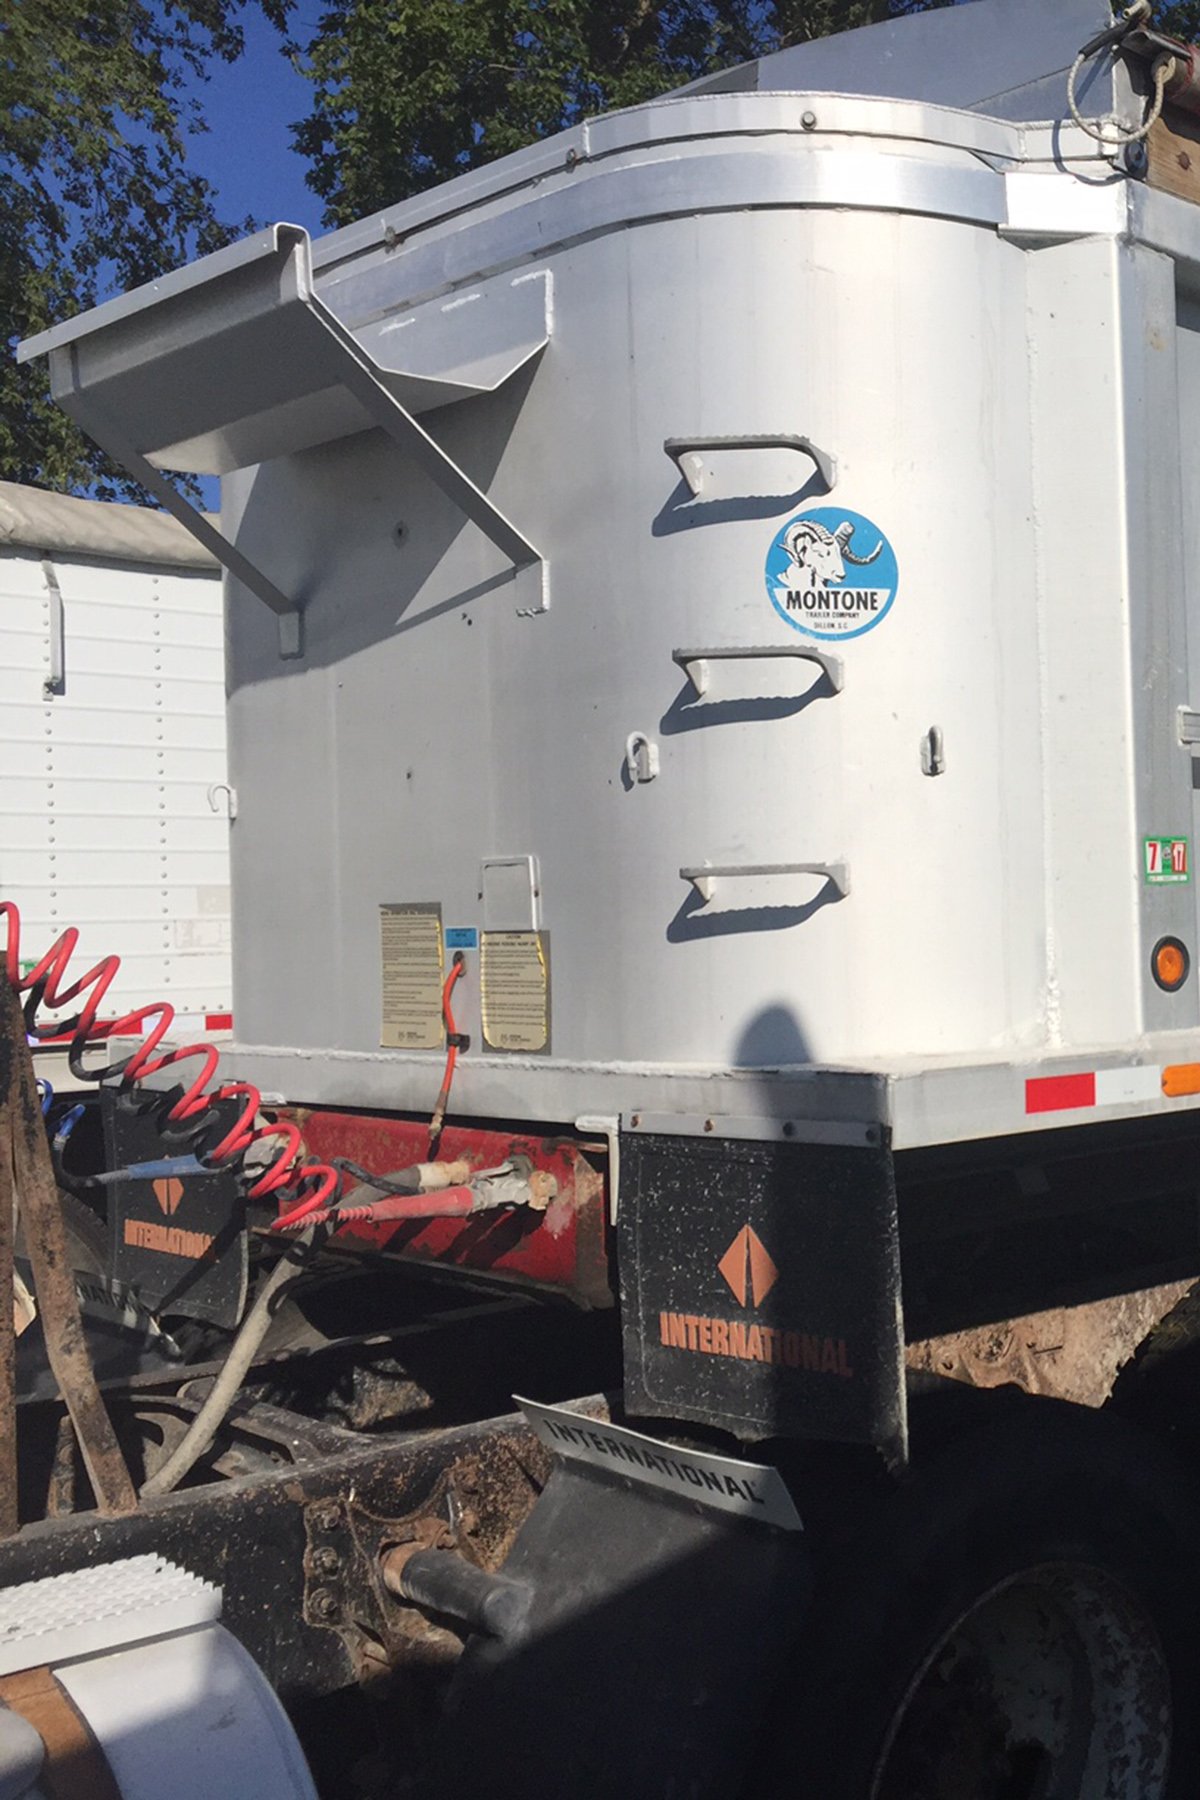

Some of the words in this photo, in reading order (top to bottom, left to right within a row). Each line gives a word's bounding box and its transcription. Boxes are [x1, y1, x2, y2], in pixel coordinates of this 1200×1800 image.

[786, 590, 878, 611] MONTONE
[832, 611, 859, 619] COMPANY
[1148, 842, 1158, 872] 7
[659, 1311, 853, 1377] INTERNATIONAL
[543, 1418, 765, 1504] INTERNATIONAL
